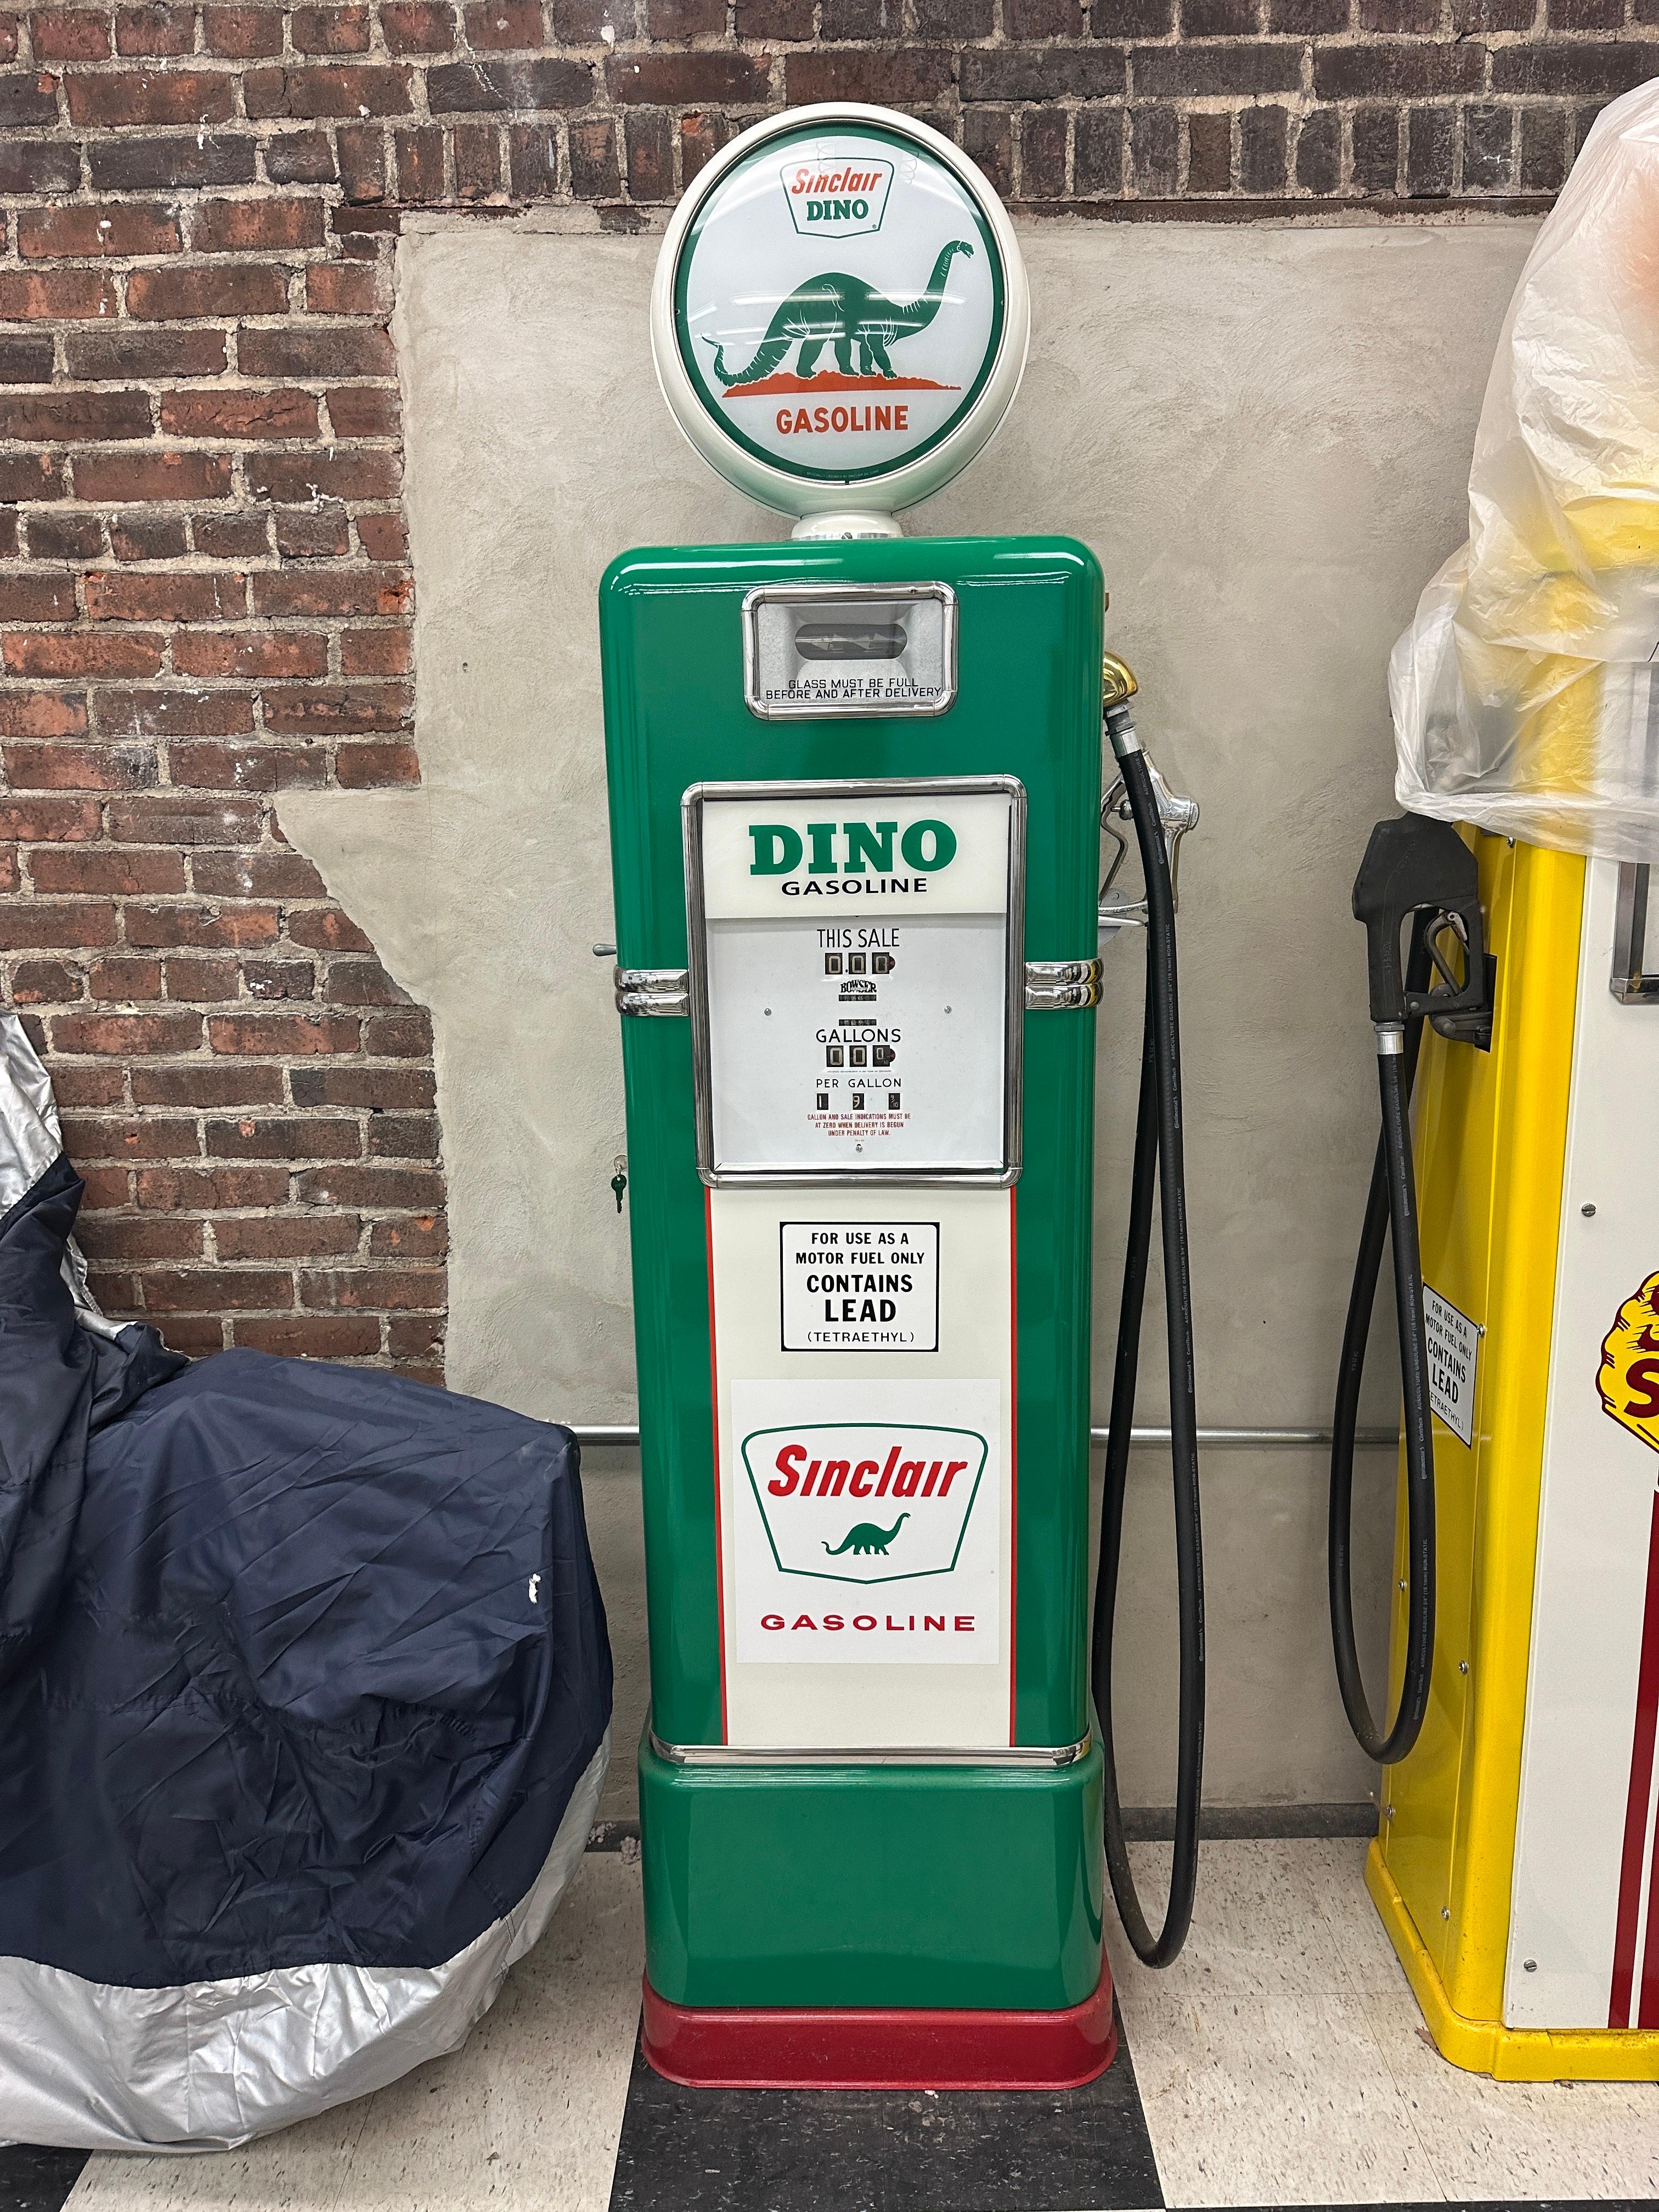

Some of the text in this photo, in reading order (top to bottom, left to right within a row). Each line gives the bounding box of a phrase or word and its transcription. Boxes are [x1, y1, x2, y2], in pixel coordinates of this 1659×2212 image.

[792, 167, 882, 194] Sinclair
[806, 199, 868, 221] DINO
[776, 405, 909, 435] GASOLINE
[766, 687, 941, 699] BEFORE AND AFTER DELIVERY
[789, 678, 918, 689] GLASS MUST BE FULL
[1135, 757, 1150, 795] AGRICULTURE
[749, 819, 957, 876] DINO
[781, 878, 927, 896] GASOLINE
[817, 928, 900, 949] THIS SALE
[840, 979, 877, 993] BOWSER
[816, 1029, 901, 1043] GALLONS
[816, 1078, 901, 1088] PER GALLON
[1395, 1111, 1403, 1149] AGRICULTURE
[811, 1232, 909, 1245] FOR USE AS A
[795, 1252, 925, 1265] MOTOR FUEL ONLY
[806, 1274, 913, 1293] CONTAINS
[825, 1299, 897, 1323] LEAD
[1432, 1300, 1468, 1339] FOR USE AS A
[807, 1331, 915, 1343] (TETRAETHYL)
[1425, 1313, 1472, 1362] MOTOR FUEL ONLY
[1427, 1336, 1466, 1383] CONTAINS
[1432, 1363, 1459, 1404] LEAD
[768, 1444, 968, 1498] Sinclair
[760, 1615, 975, 1632] GASOLINE
